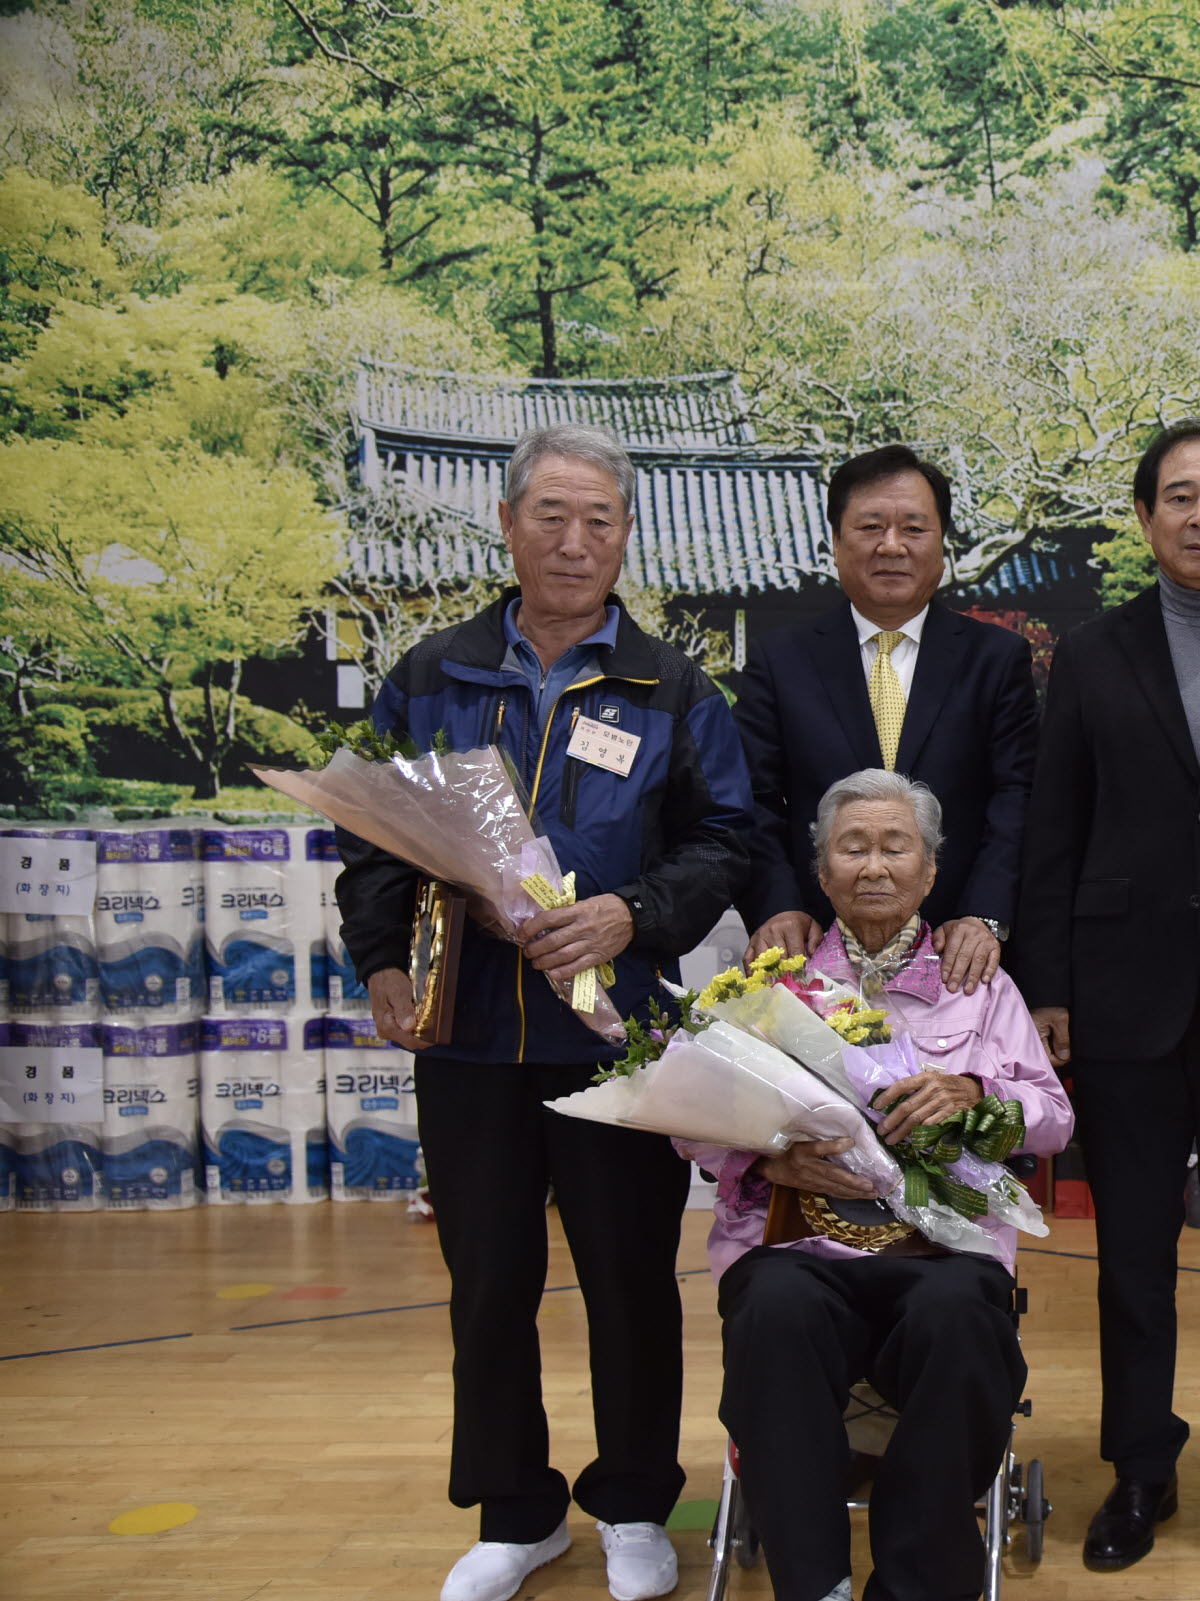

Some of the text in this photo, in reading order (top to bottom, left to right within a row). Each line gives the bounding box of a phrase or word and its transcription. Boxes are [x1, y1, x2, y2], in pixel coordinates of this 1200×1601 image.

[97, 895, 163, 912] 크리넥스
[220, 892, 286, 910] 크리넥스
[214, 1081, 283, 1099] 크리넥스
